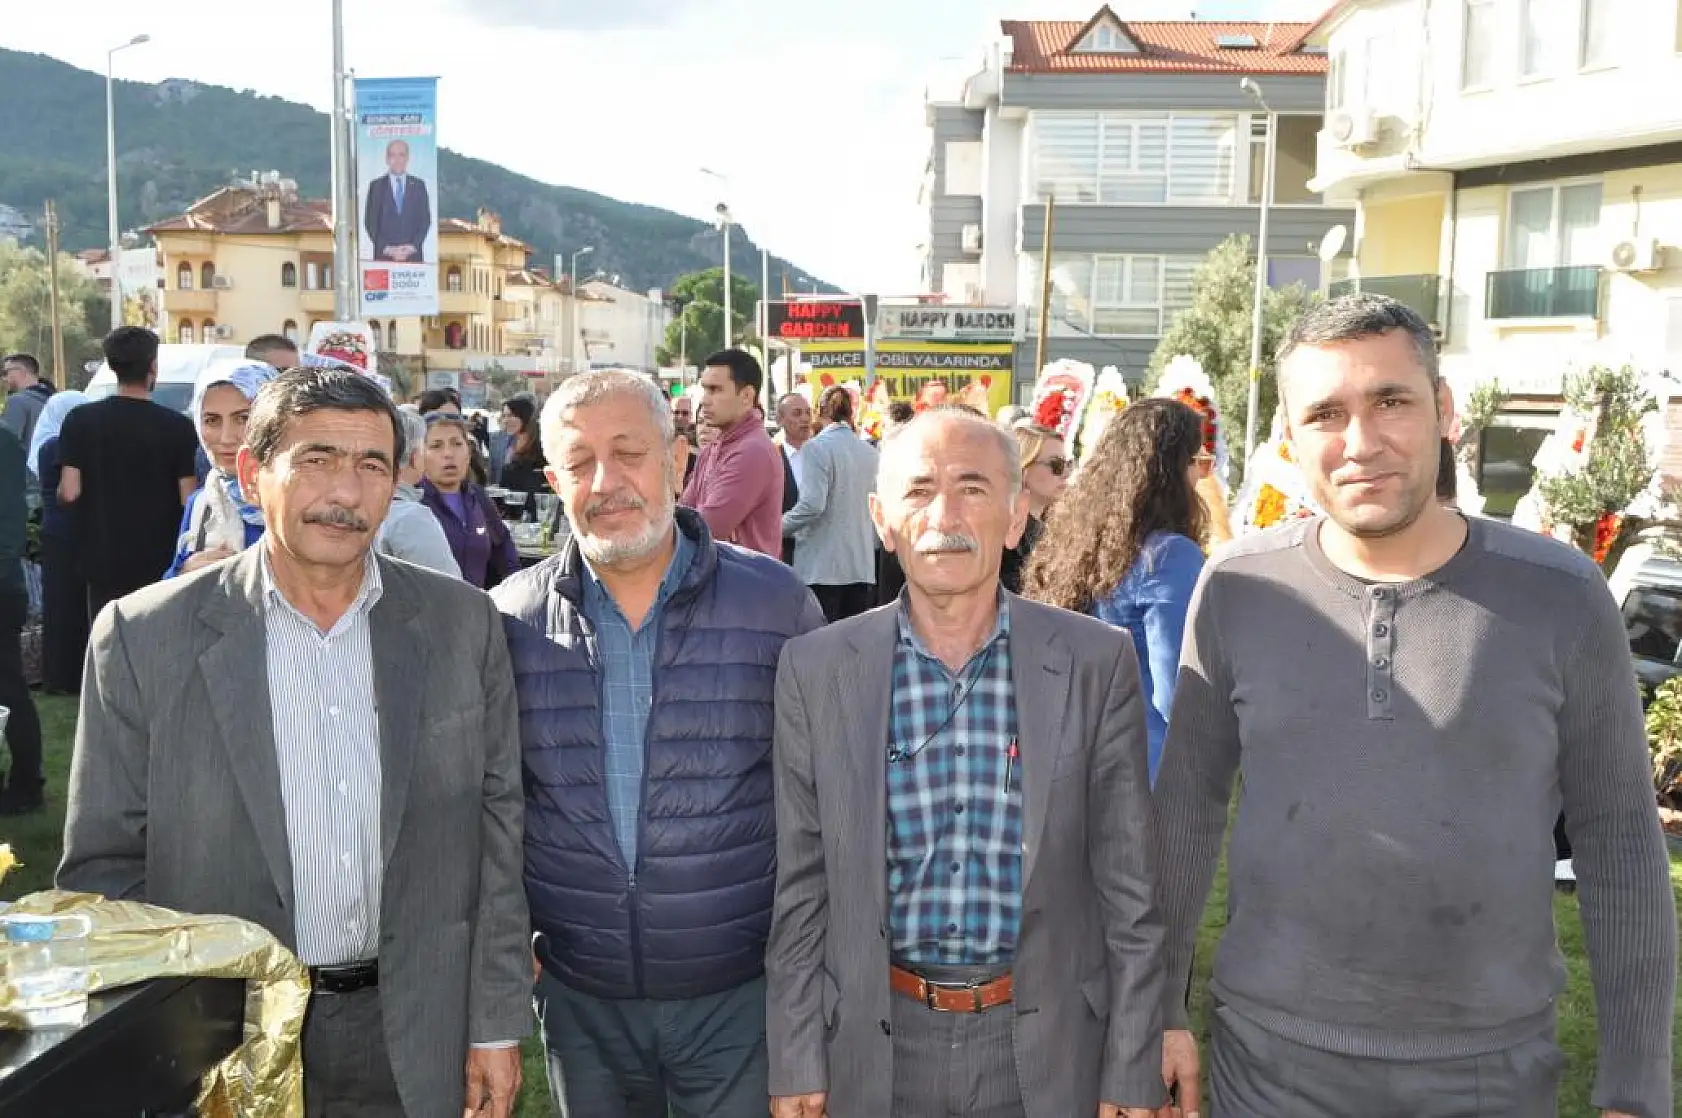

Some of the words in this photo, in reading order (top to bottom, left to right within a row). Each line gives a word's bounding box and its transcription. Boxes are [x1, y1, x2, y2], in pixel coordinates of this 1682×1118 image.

[788, 301, 842, 318] HAPPY
[900, 312, 948, 328] HAPPY
[780, 322, 849, 337] GARDEN
[875, 353, 1001, 366] OBİLYALARINDA
